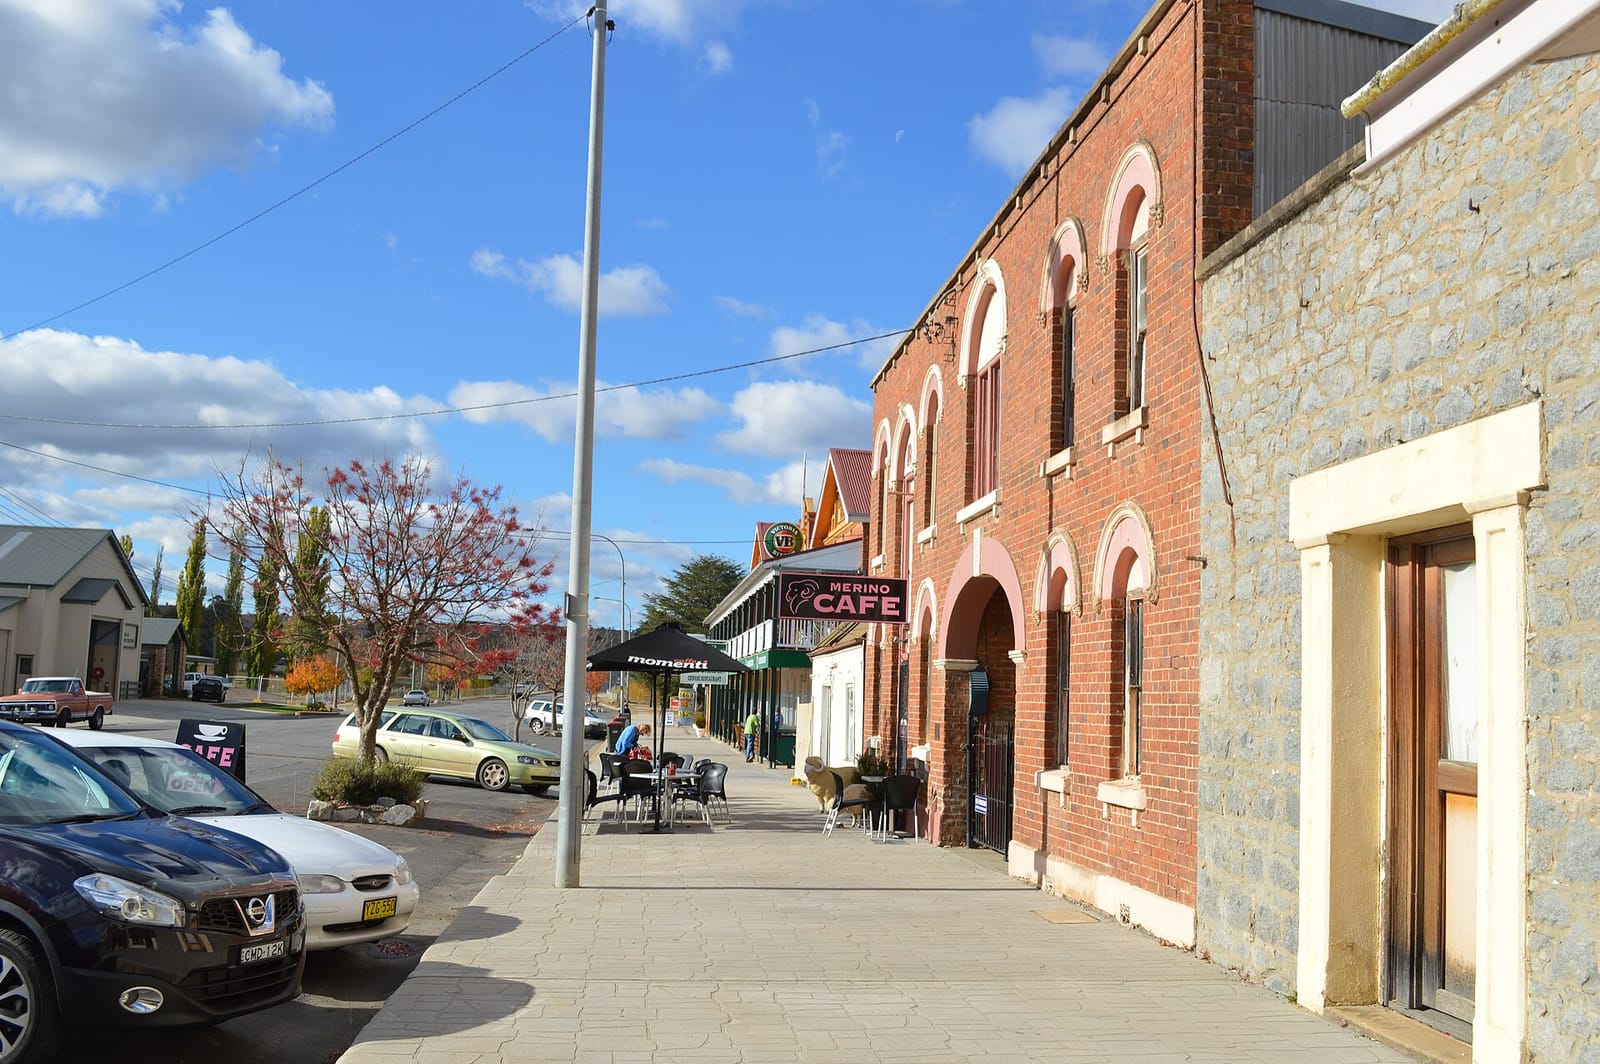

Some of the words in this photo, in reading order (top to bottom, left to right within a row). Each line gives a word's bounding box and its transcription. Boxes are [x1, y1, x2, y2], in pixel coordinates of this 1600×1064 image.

[770, 524, 799, 536] VICTORIA
[775, 535, 794, 548] VB
[830, 582, 890, 594] MERINO
[813, 593, 900, 616] CAFE
[627, 655, 709, 670] momenti
[171, 777, 216, 794] OPEN
